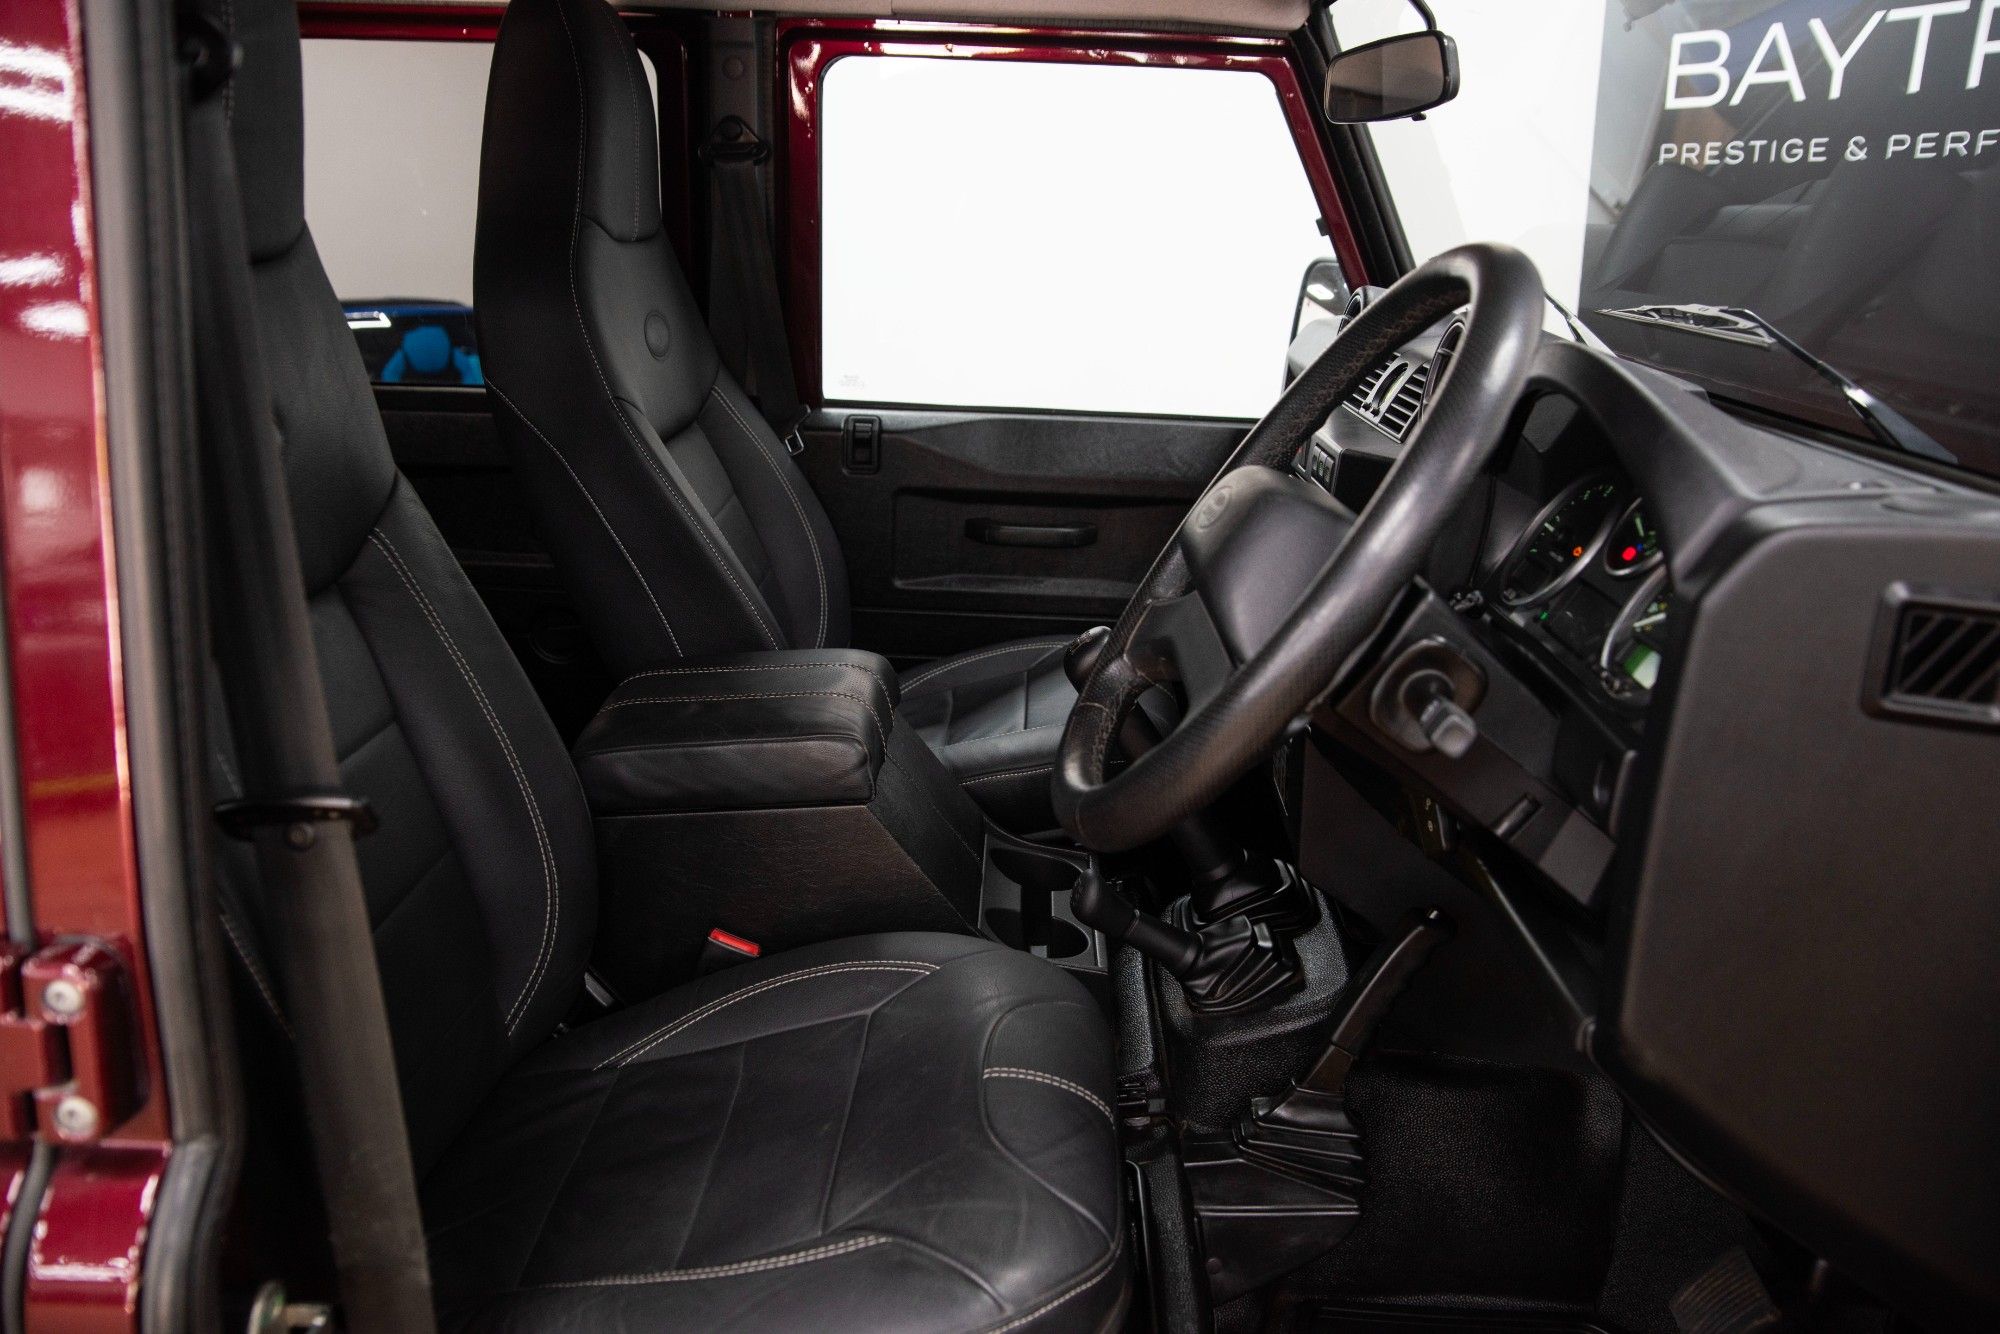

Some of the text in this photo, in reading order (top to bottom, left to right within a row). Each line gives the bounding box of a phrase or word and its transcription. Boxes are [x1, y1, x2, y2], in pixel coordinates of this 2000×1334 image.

[1658, 129, 2000, 166] PRESTIGE & PERF
